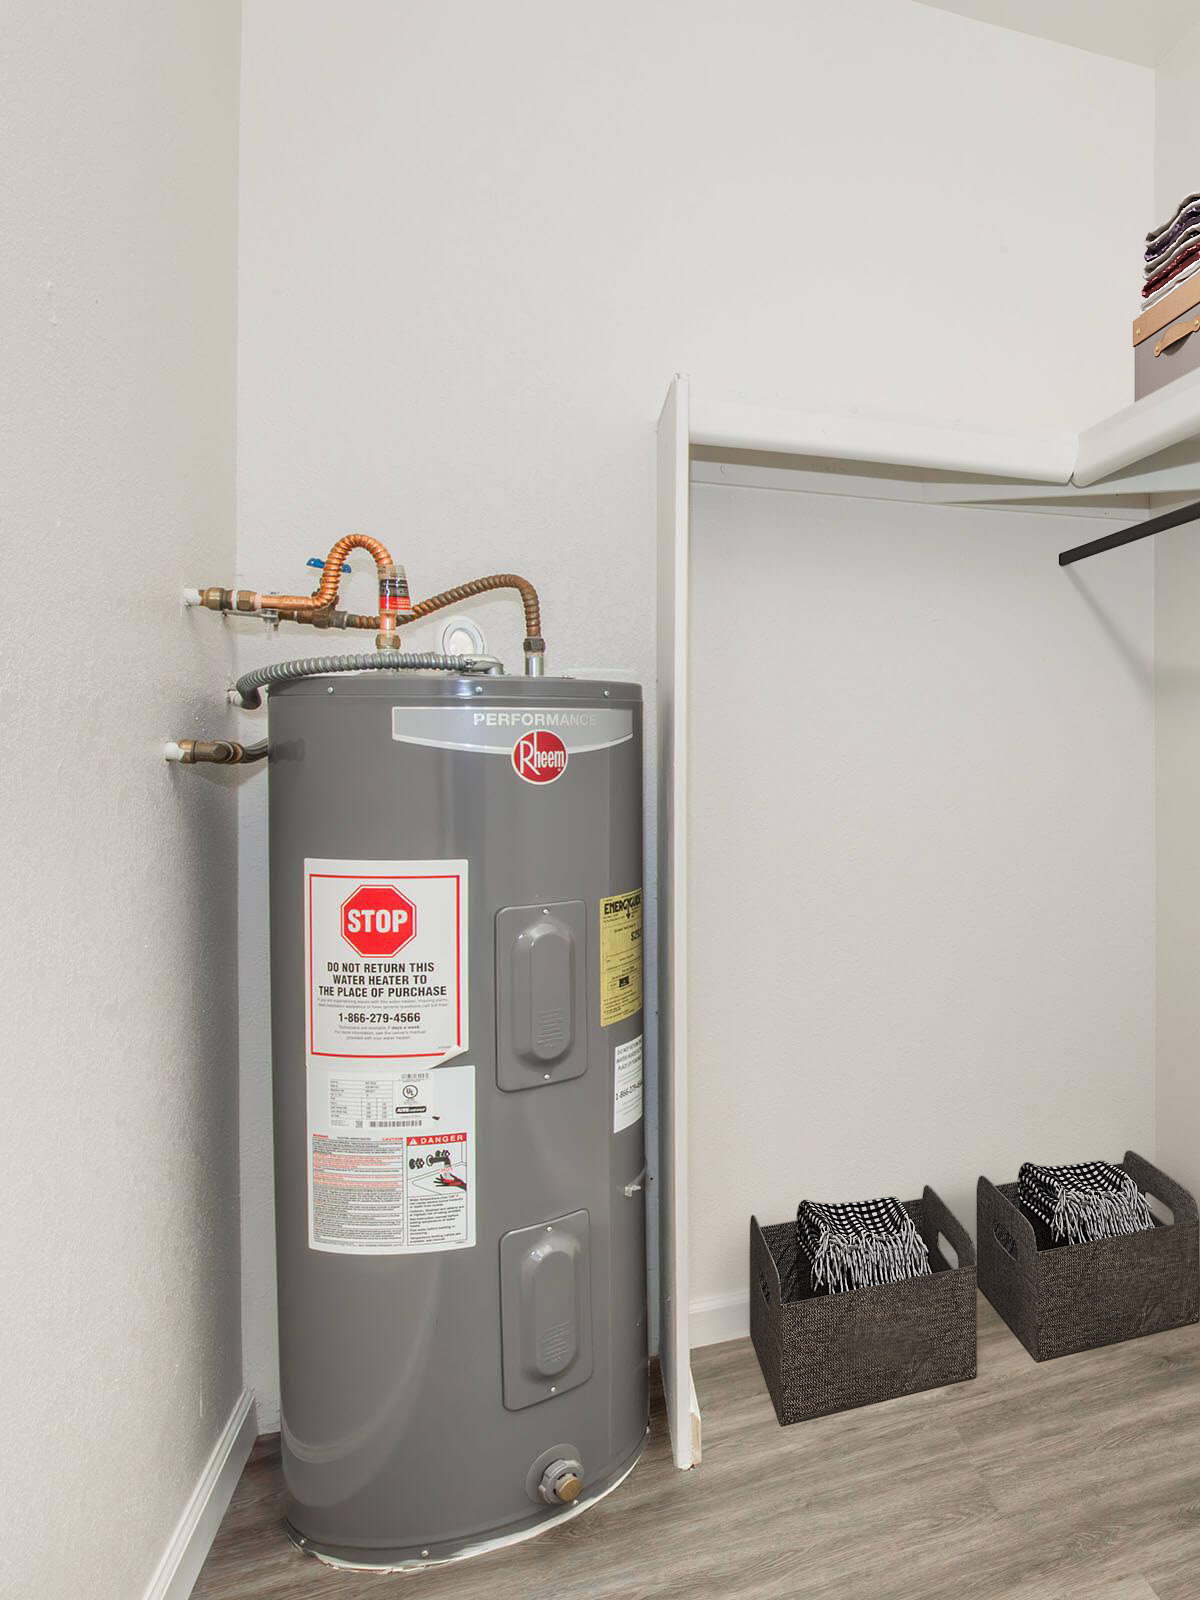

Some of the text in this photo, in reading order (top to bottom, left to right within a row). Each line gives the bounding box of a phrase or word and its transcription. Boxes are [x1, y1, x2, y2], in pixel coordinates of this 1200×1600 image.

[473, 713, 598, 726] PERFORMANCE
[519, 731, 565, 776] Rheem
[347, 909, 408, 933] STOP
[327, 962, 435, 973] DO NOT RETURN THIS
[333, 974, 428, 985] WATER HEATER TO
[319, 985, 447, 997] THE PLACE OF PURCHASE
[338, 1012, 421, 1023] 1-866-279-4566
[420, 1134, 463, 1145] DANGER
